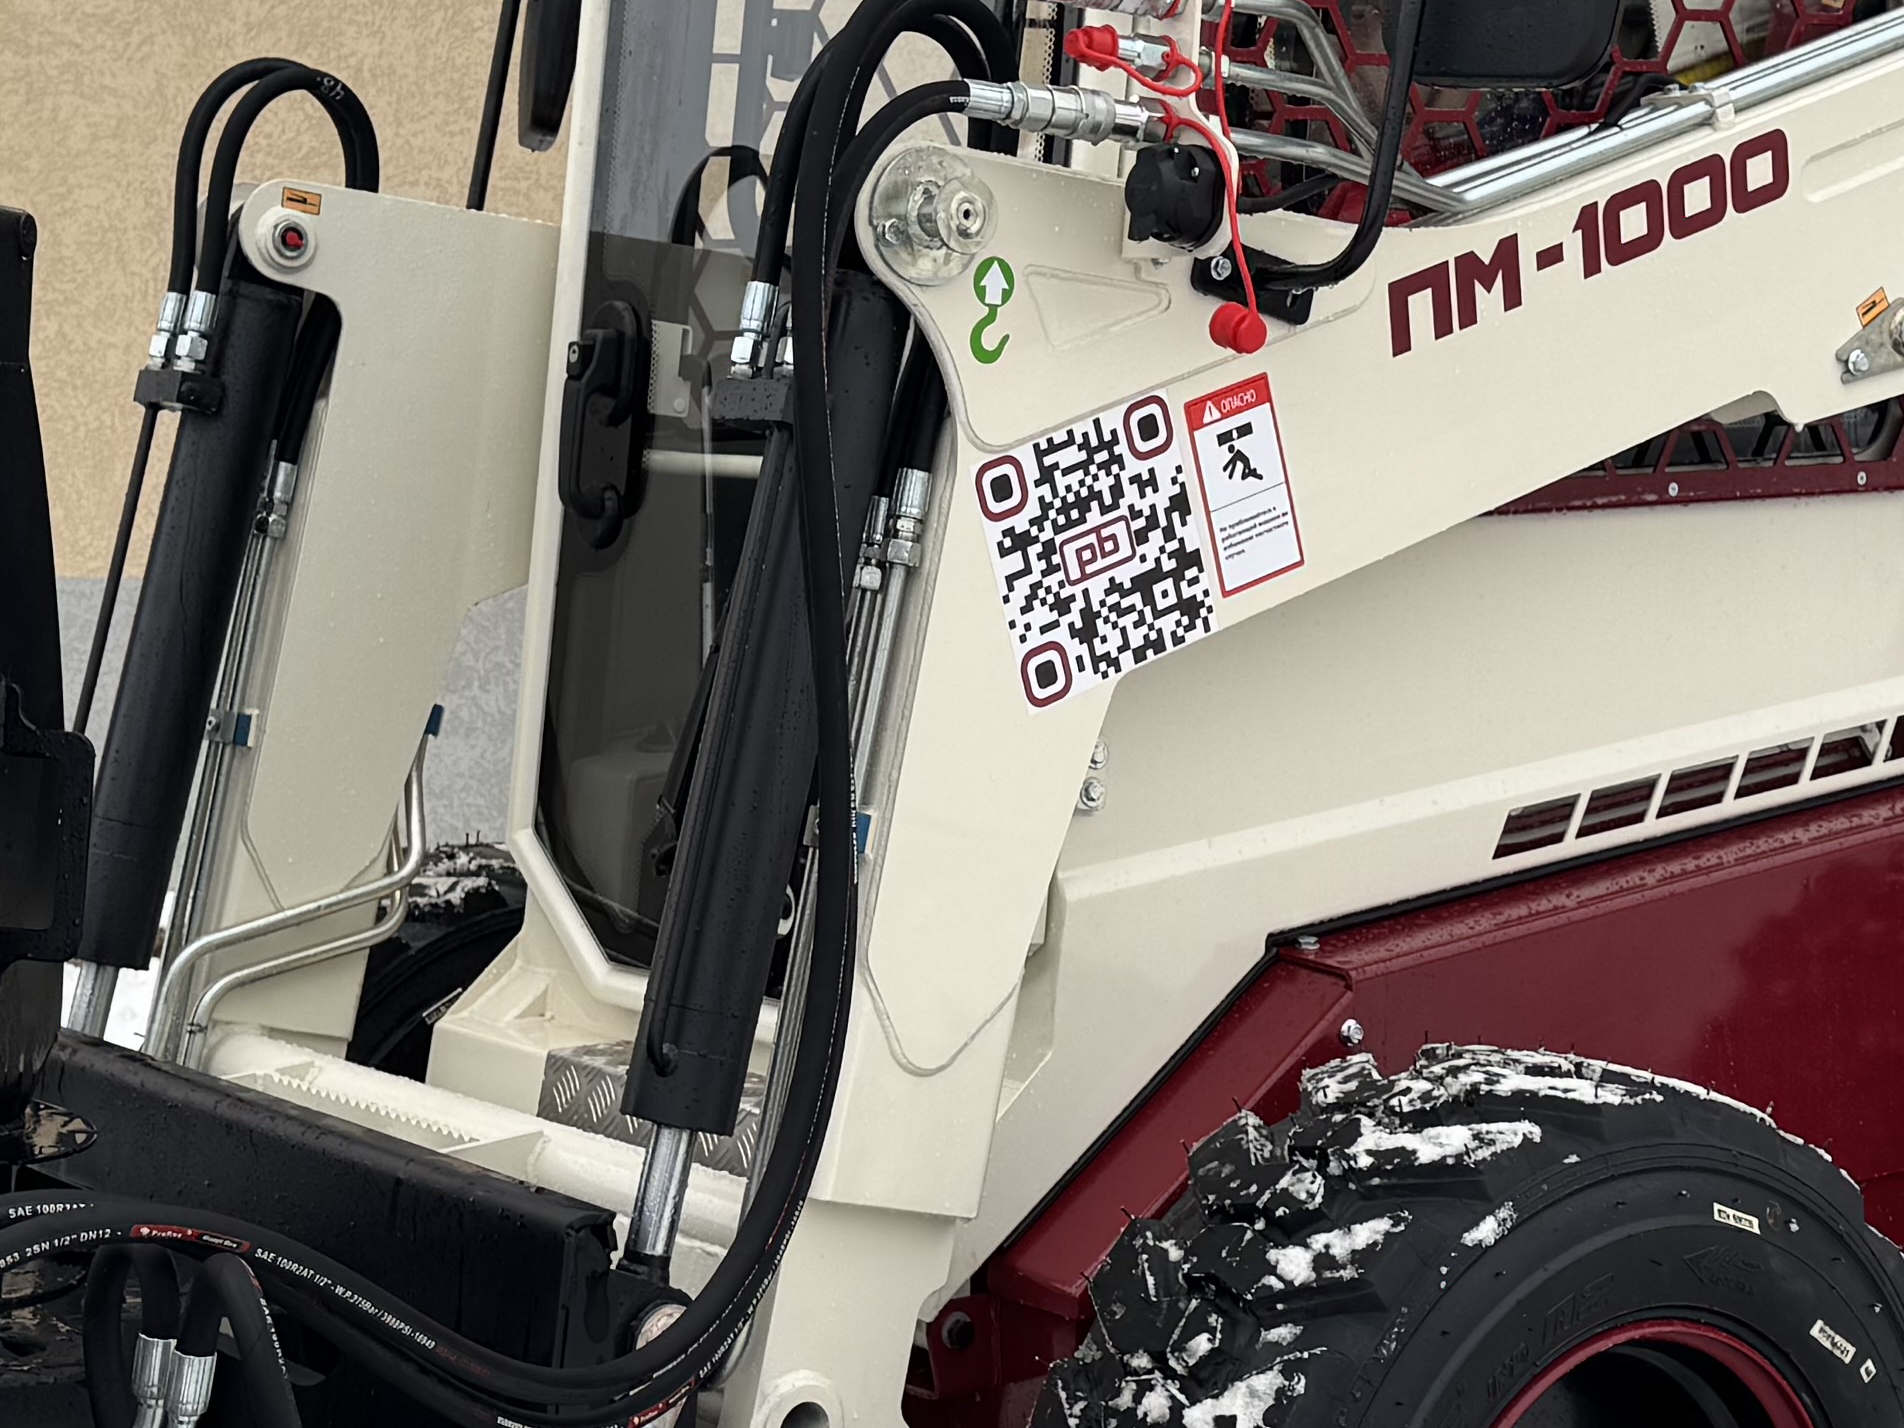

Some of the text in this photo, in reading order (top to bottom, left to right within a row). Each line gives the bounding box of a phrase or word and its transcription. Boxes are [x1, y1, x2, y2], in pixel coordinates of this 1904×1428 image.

[1387, 128, 1790, 358] ПМ-1000
[1220, 389, 1257, 414] ОПАСНО
[8, 1205, 33, 1219] SAE
[25, 1241, 50, 1258] 2SN
[80, 1228, 111, 1244] DN12
[254, 1248, 277, 1264] SAE
